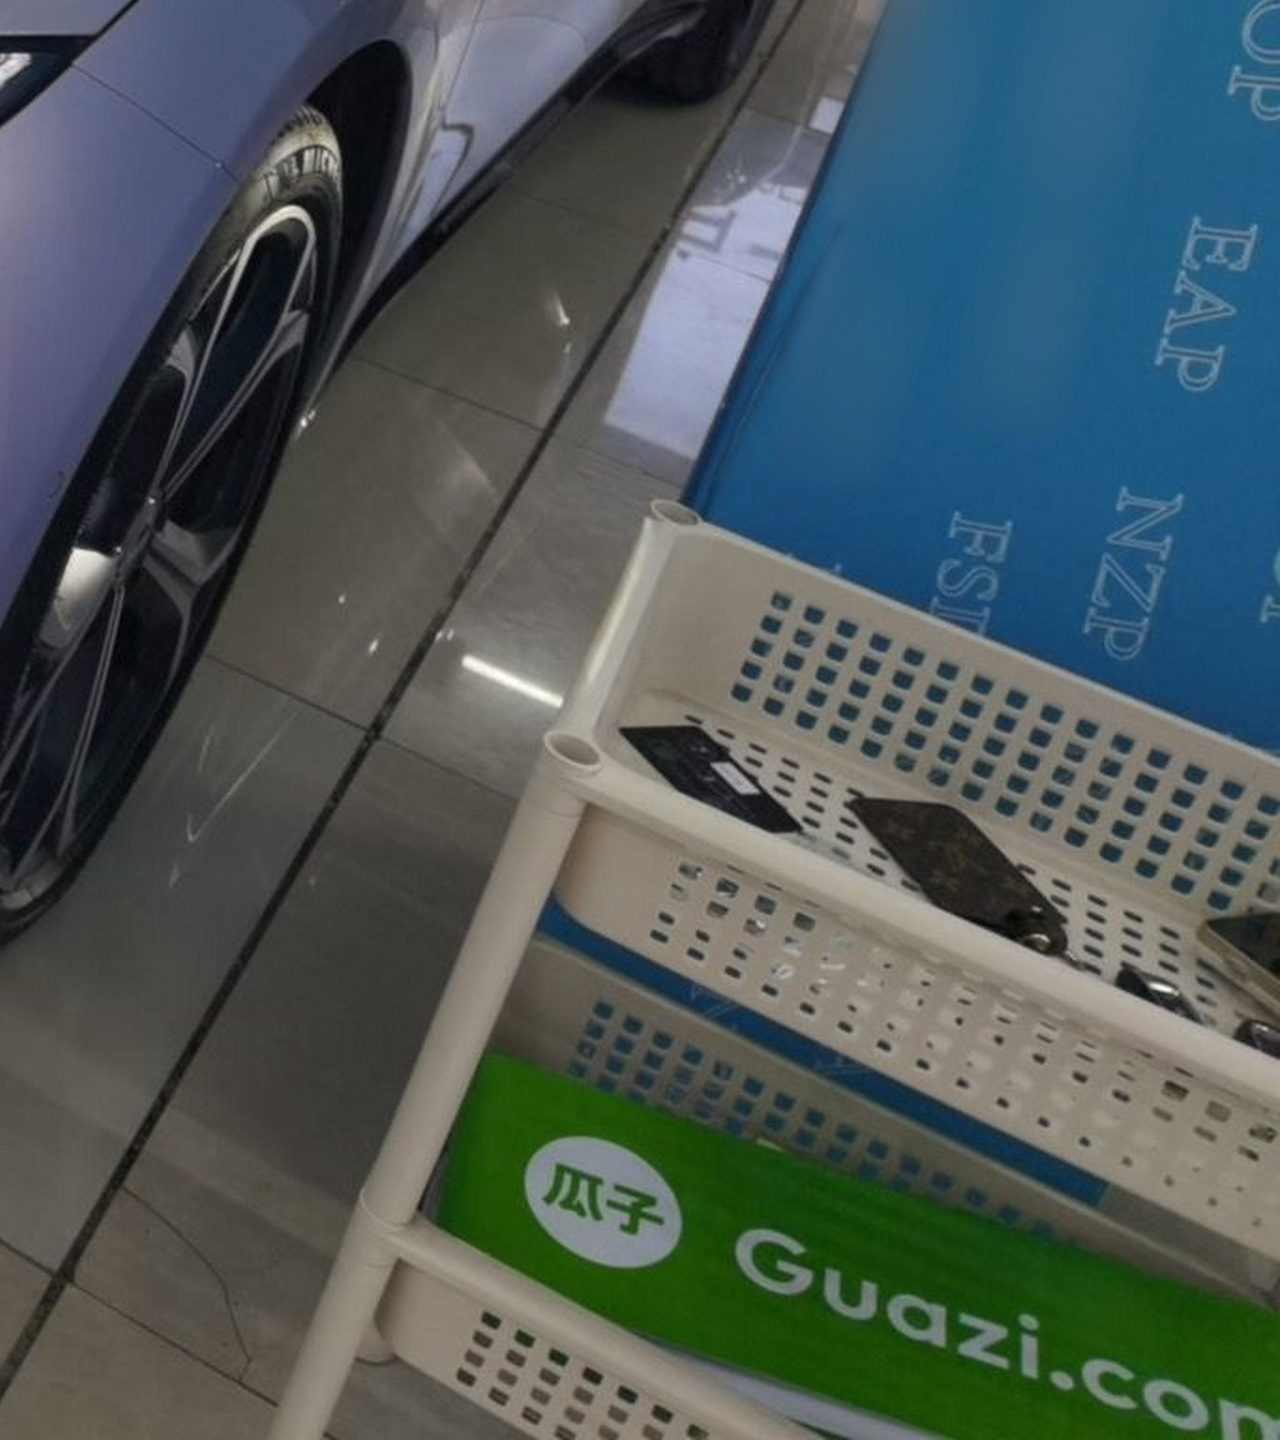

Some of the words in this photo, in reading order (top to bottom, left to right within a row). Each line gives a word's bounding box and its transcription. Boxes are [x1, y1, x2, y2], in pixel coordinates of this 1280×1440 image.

[1154, 215, 1259, 392] EAP
[1082, 485, 1184, 661] NZP
[542, 1162, 665, 1236] 瓜子
